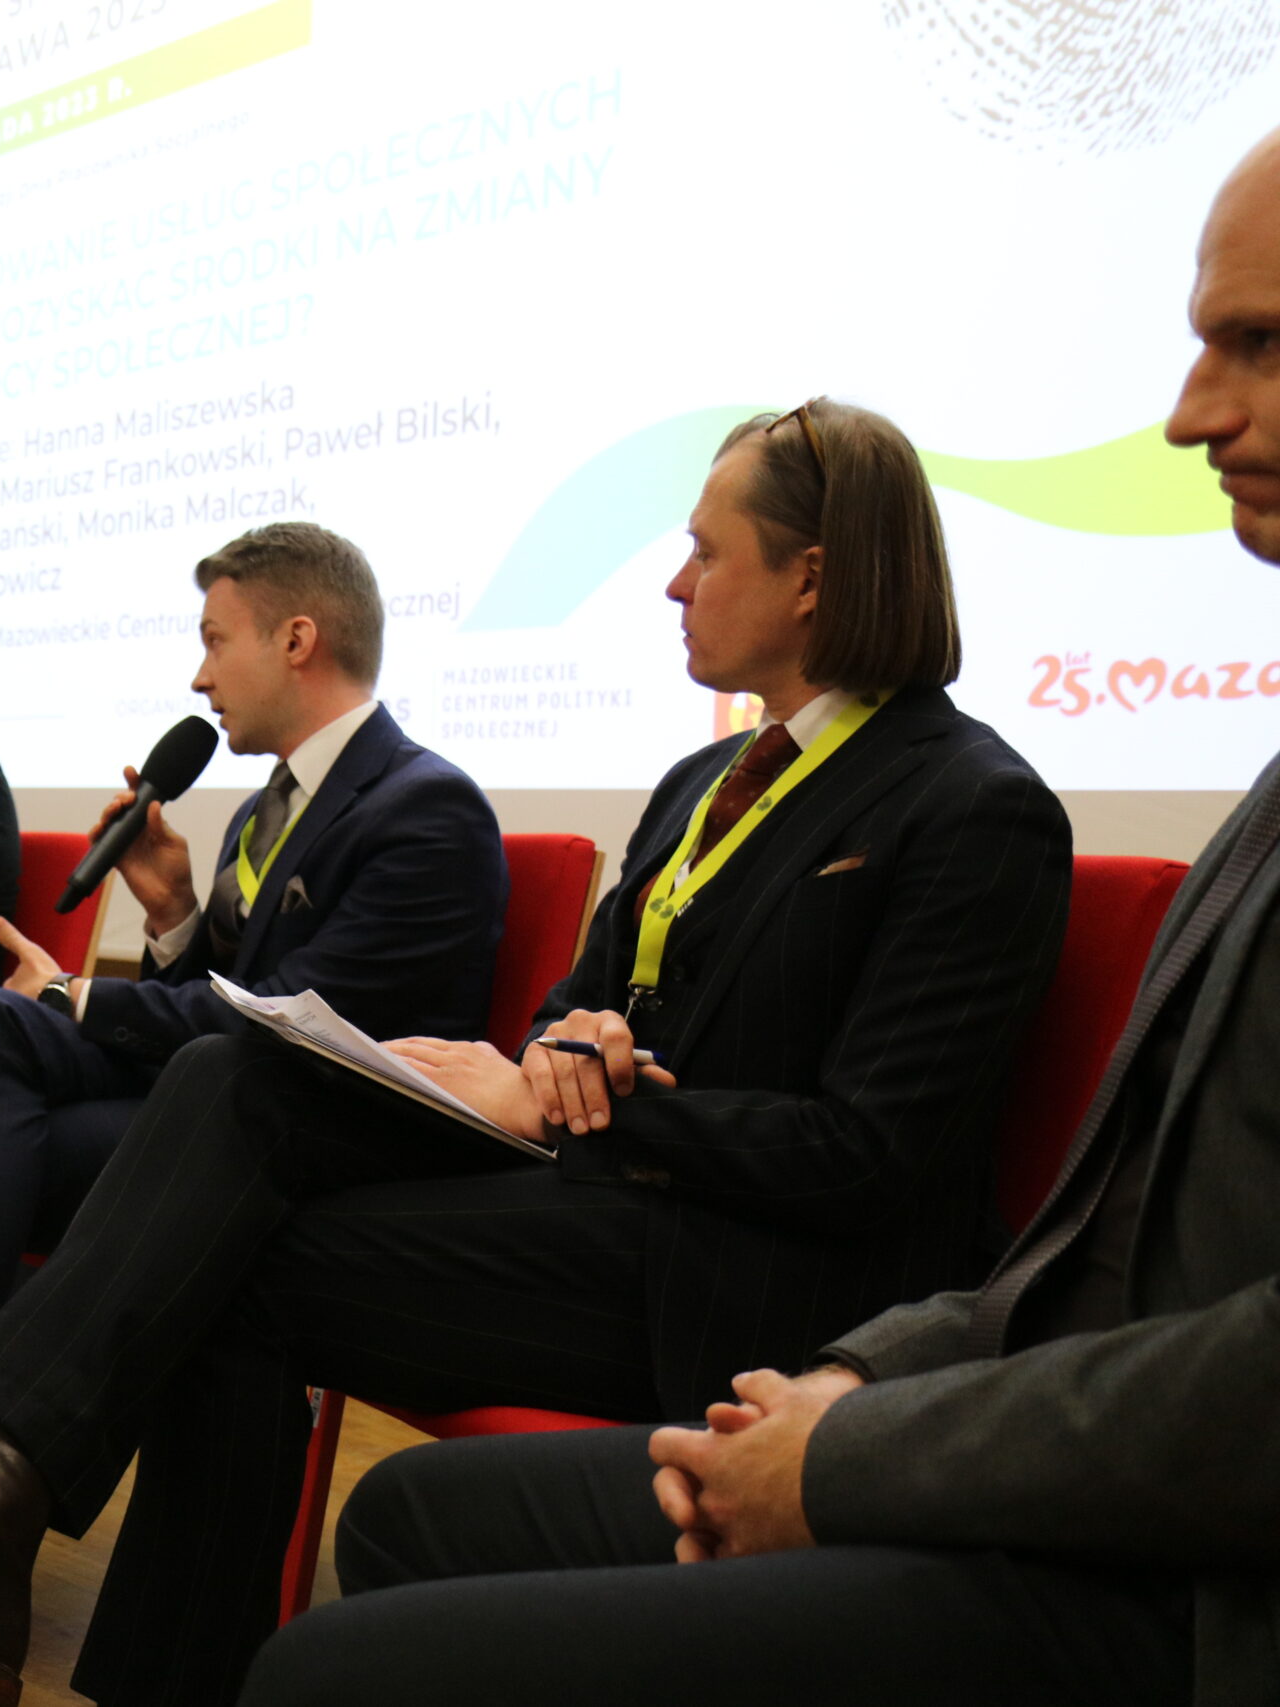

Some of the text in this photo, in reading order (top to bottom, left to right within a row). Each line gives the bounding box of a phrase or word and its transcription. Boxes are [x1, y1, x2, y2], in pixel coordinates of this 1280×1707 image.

[130, 177, 256, 250] USŁUG
[270, 65, 622, 212] SPOŁECZNYCH
[335, 206, 399, 261] NA
[412, 144, 615, 241] ZMIANY
[53, 292, 316, 390] SPOŁECZNEJ?
[0, 465, 95, 507] Mariusz
[103, 429, 273, 490] Frankowski,
[283, 410, 386, 462] Paweł
[394, 388, 502, 445] Bilski,
[22, 420, 105, 459] Hanna
[114, 379, 296, 443] Maliszewska
[77, 498, 175, 541] Monika
[184, 476, 317, 528] Malczak,
[440, 691, 530, 714] CENTRUM
[536, 687, 634, 711] POLITYKI
[441, 662, 580, 686] MAZOWIECKIE
[440, 718, 560, 742] SPOŁECZNEJ
